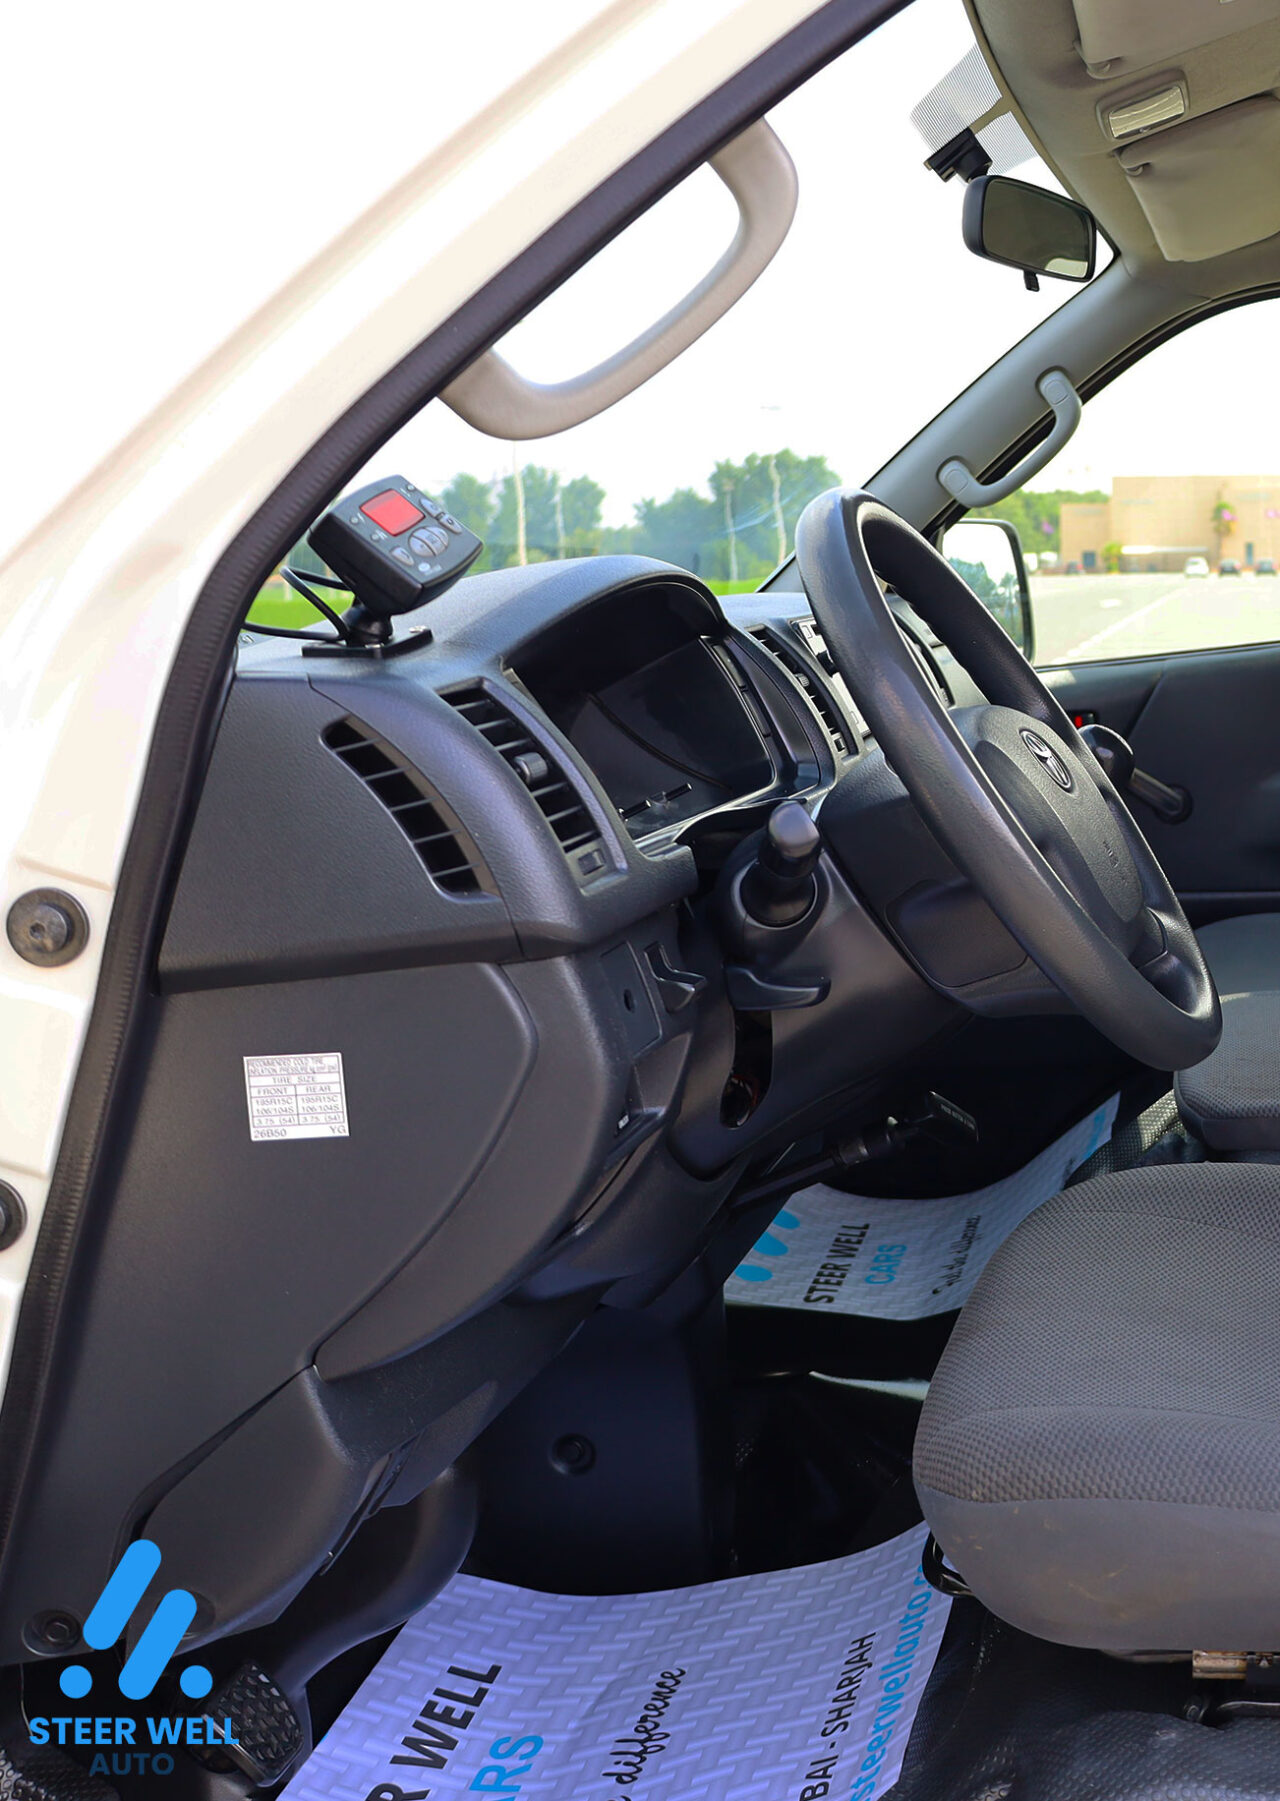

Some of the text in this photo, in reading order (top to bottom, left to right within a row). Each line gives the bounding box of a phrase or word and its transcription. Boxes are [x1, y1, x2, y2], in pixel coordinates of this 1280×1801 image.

[257, 1086, 288, 1096] FRONT
[297, 1075, 317, 1083] SIZE
[306, 1084, 332, 1093] REAR
[803, 1223, 871, 1304] STEER WELL
[864, 1243, 908, 1285] CARS
[389, 1663, 502, 1770] WELL
[603, 1667, 687, 1785] difference
[799, 1755, 839, 1801] BAI
[820, 1631, 877, 1739] SHARJAH
[468, 1735, 544, 1801] RS
